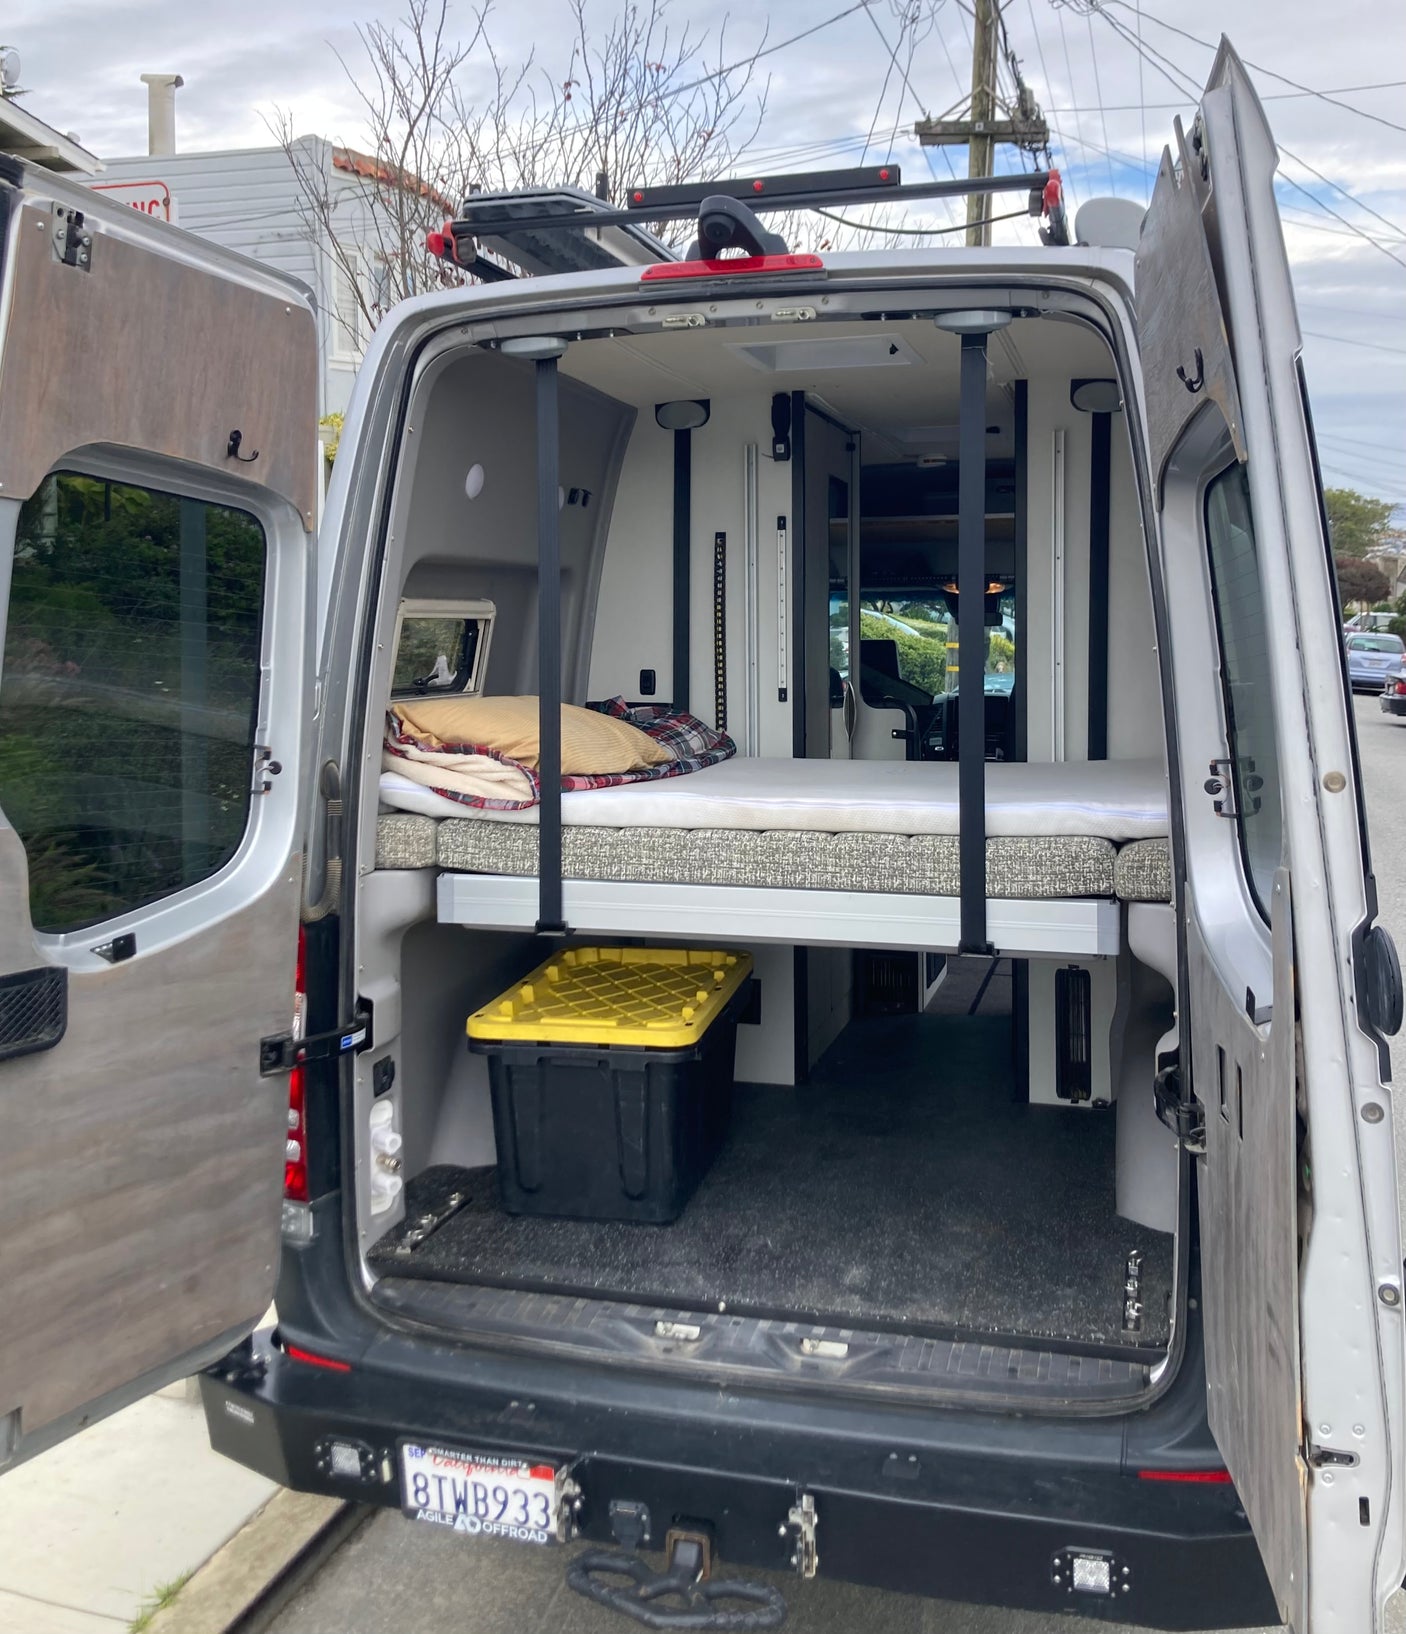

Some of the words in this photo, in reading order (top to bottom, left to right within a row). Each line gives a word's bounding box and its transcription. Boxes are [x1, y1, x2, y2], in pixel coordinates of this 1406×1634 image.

[408, 1447, 426, 1458] SEP
[433, 1448, 473, 1462] SMARTER
[474, 1454, 499, 1466] THAN
[501, 1457, 522, 1467] DIRT
[412, 1471, 550, 1530] 8TWB933
[417, 1508, 454, 1525] AGILE
[482, 1521, 548, 1543] OFFROAD
